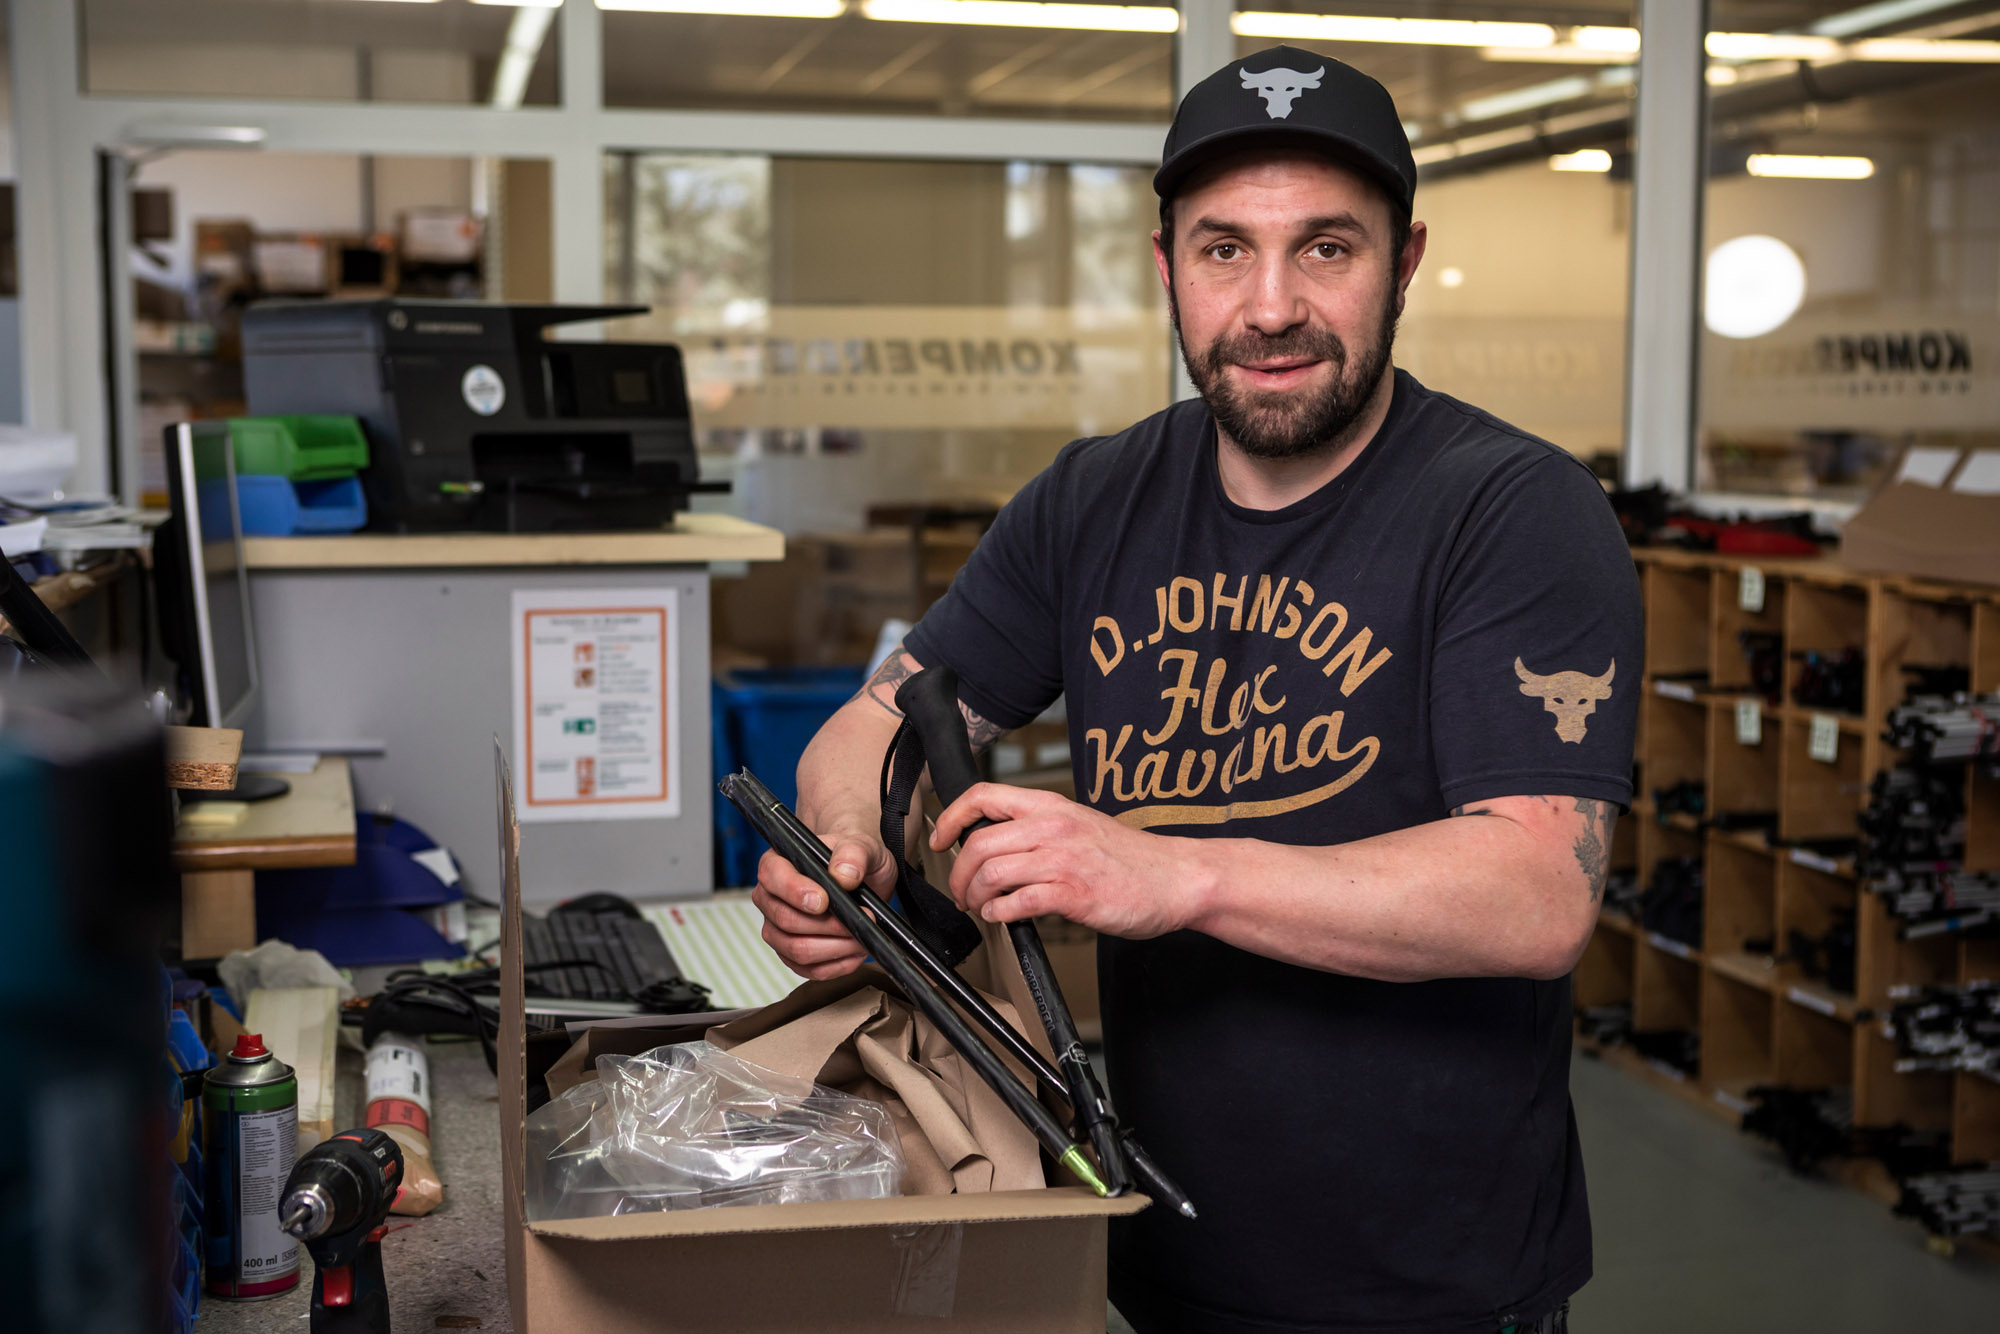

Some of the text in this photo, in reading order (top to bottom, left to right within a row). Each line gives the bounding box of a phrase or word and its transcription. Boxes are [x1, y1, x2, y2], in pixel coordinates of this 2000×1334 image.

[1142, 648, 1287, 746] Flex
[1086, 710, 1358, 804] Kavana
[1020, 952, 1056, 1032] KOMPERDELL
[243, 1257, 263, 1268] 400
[265, 1254, 278, 1266] ml
